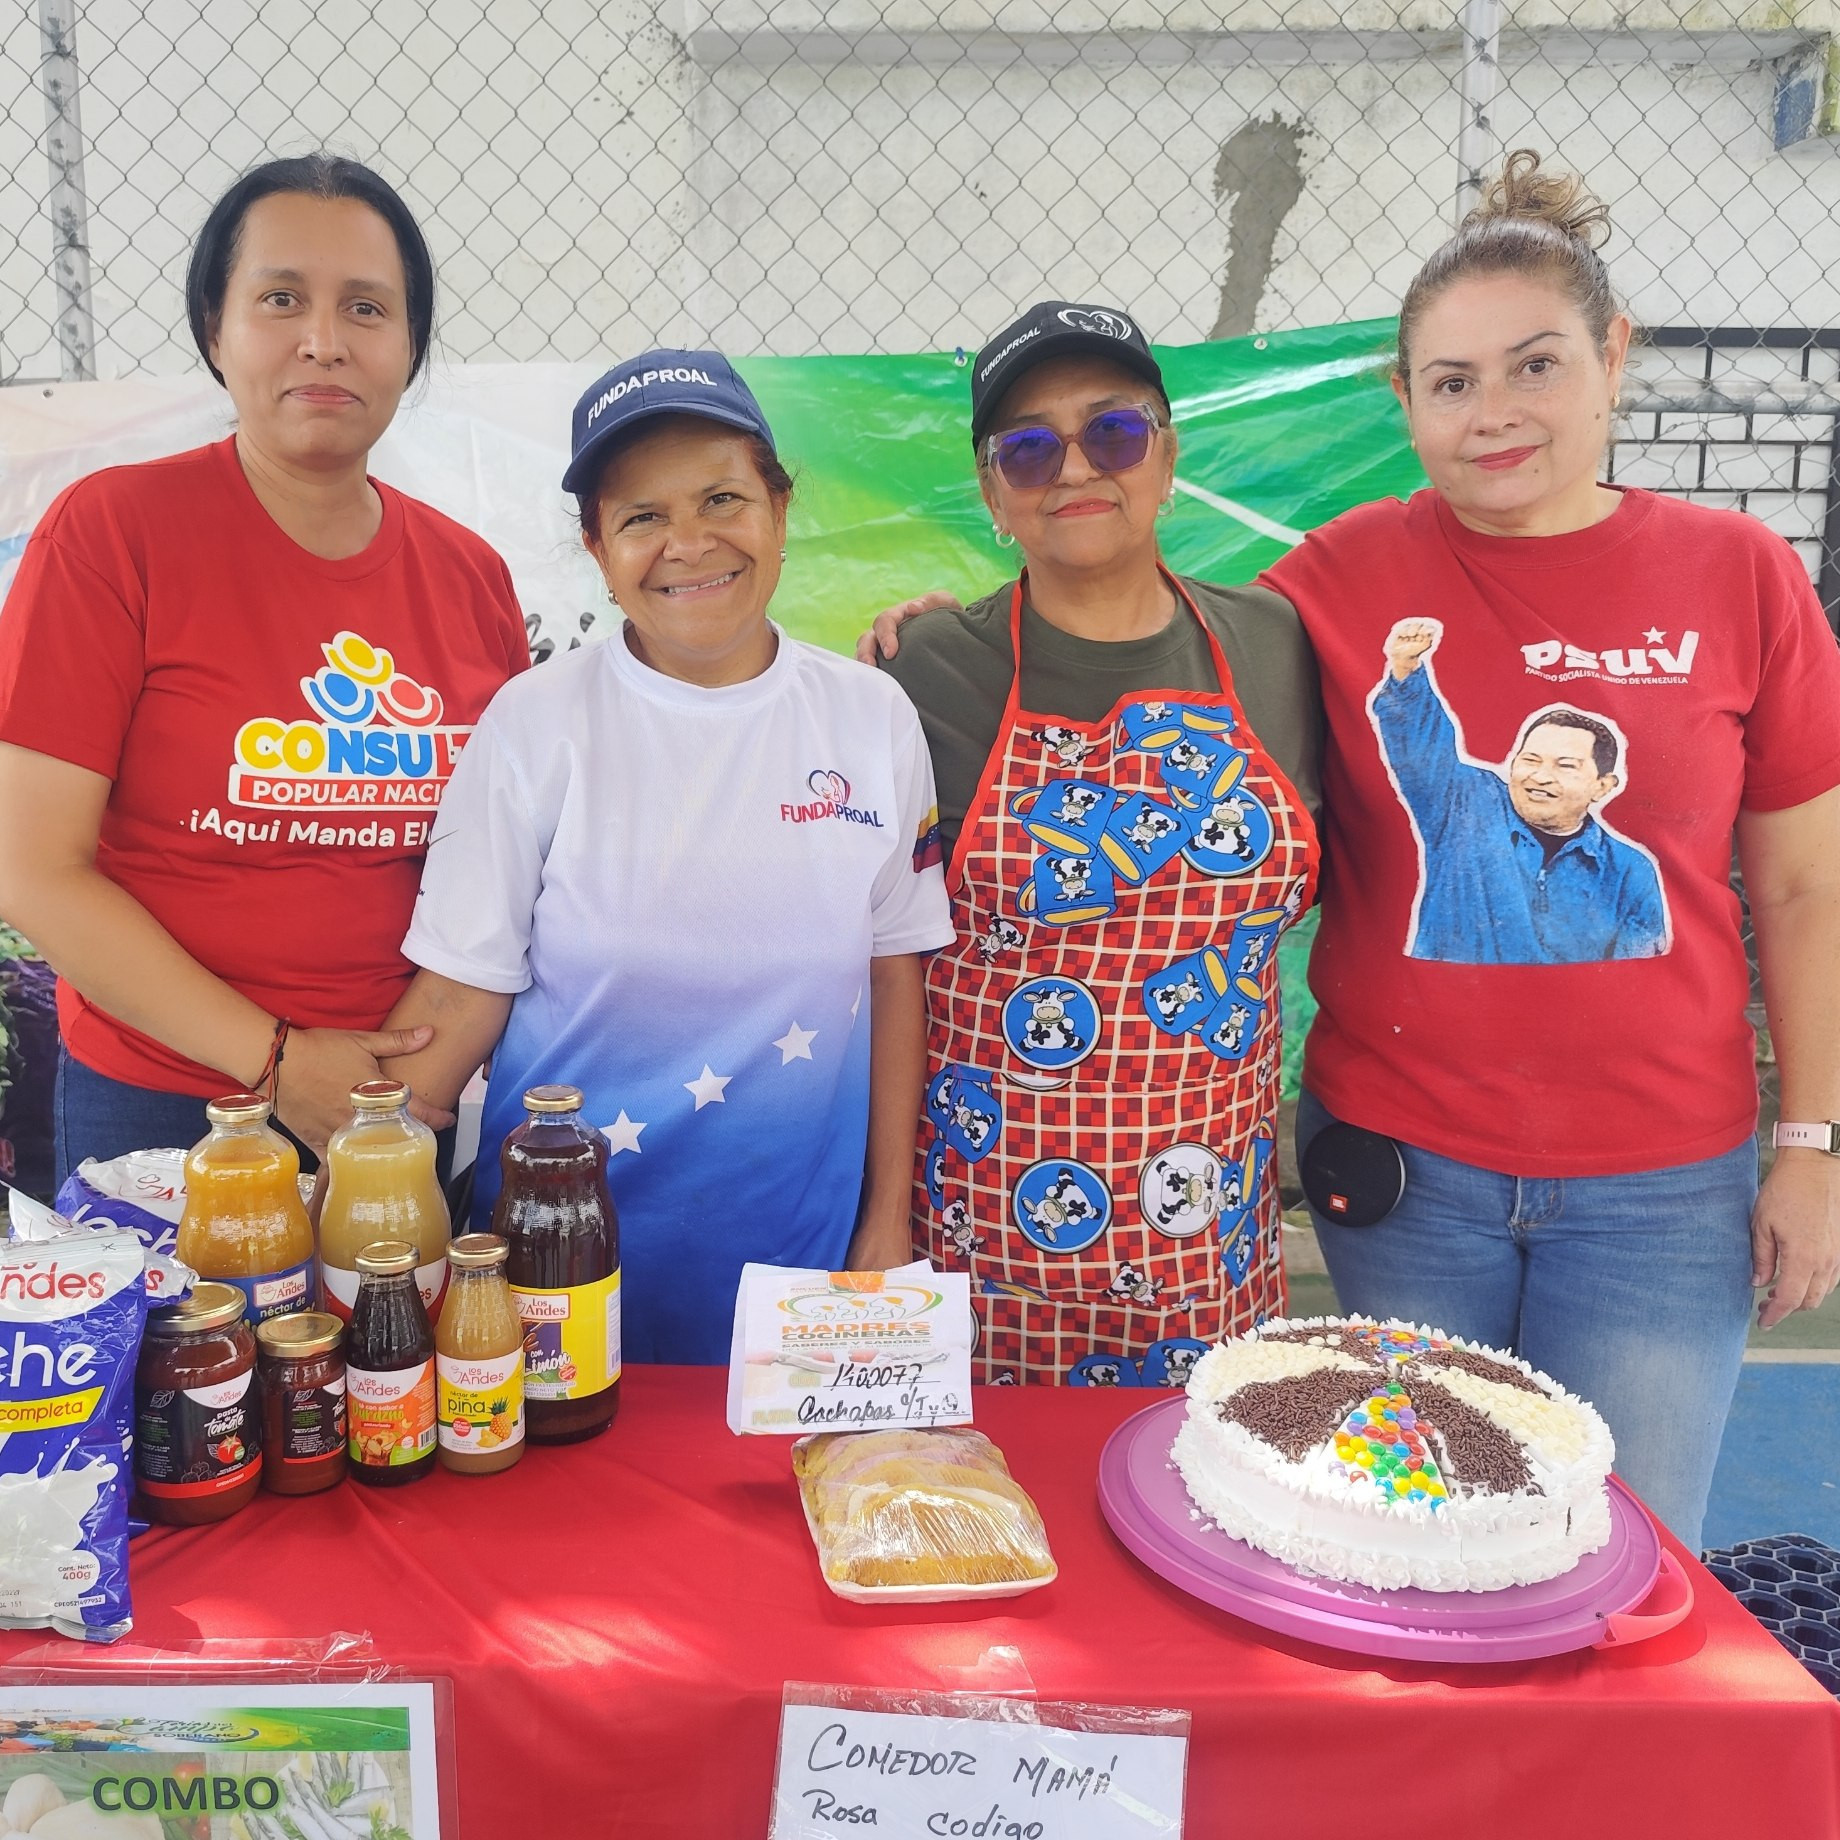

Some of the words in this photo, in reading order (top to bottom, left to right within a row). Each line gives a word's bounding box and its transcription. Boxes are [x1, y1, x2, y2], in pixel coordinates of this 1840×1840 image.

[986, 326, 1041, 383] FUNDAPROAL
[587, 368, 718, 429] FUNDAPROAL
[1525, 667, 1558, 682] PARTIDO
[1558, 669, 1601, 683] SOCIALISTA
[1602, 675, 1628, 685] UNIDO
[1628, 677, 1641, 685] DE
[1641, 676, 1689, 685] VENEZUELA
[252, 780, 376, 804] POPULAR
[780, 801, 884, 828] FUNDAPROAL
[287, 820, 396, 847] Manda
[0, 1262, 107, 1300] ndes
[282, 1279, 295, 1290] Los
[276, 1282, 306, 1299] Andes
[259, 1302, 294, 1319] néctar
[296, 1296, 307, 1309] de
[525, 1304, 566, 1317] Andes
[532, 1297, 548, 1307] Los
[781, 1321, 931, 1334] MADRES
[781, 1330, 931, 1341] COCINERAS
[460, 1372, 504, 1385] Andes
[357, 1383, 400, 1396] Andes
[217, 1407, 238, 1420] pasta
[447, 1397, 486, 1414] piña
[62, 1570, 92, 1581] 400g
[93, 1776, 280, 1811] COMBO
[801, 1788, 878, 1826] Rosa
